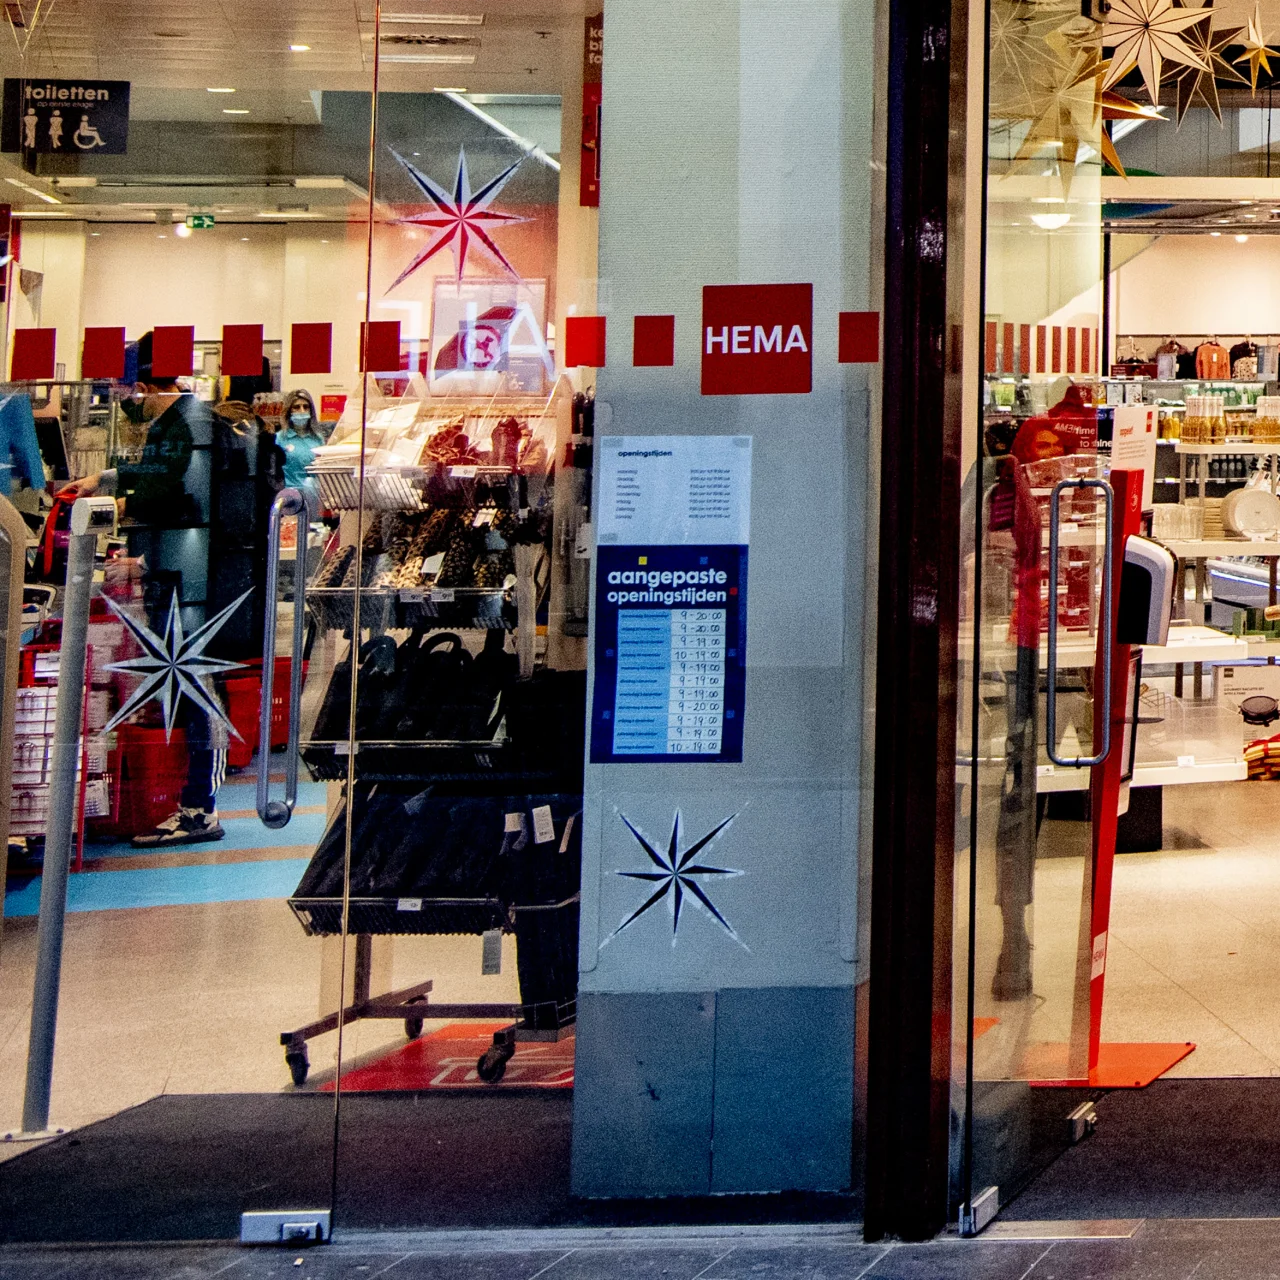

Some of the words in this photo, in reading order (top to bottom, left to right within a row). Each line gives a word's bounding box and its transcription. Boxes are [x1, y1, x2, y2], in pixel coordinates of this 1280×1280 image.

[25, 84, 109, 101] toiletten
[706, 324, 808, 354] HEMA
[618, 450, 673, 458] openingstijden
[607, 568, 727, 587] aangepaste
[607, 588, 727, 605] openingstijden
[680, 610, 687, 620] 9
[681, 623, 687, 633] 9
[680, 636, 686, 646] 9
[675, 651, 687, 660] 10
[680, 662, 686, 672] 9
[679, 675, 685, 686] 9
[679, 689, 685, 699] 9
[678, 702, 684, 712] 9
[677, 715, 683, 725] 9
[676, 727, 682, 737] 9
[670, 743, 682, 752] 10
